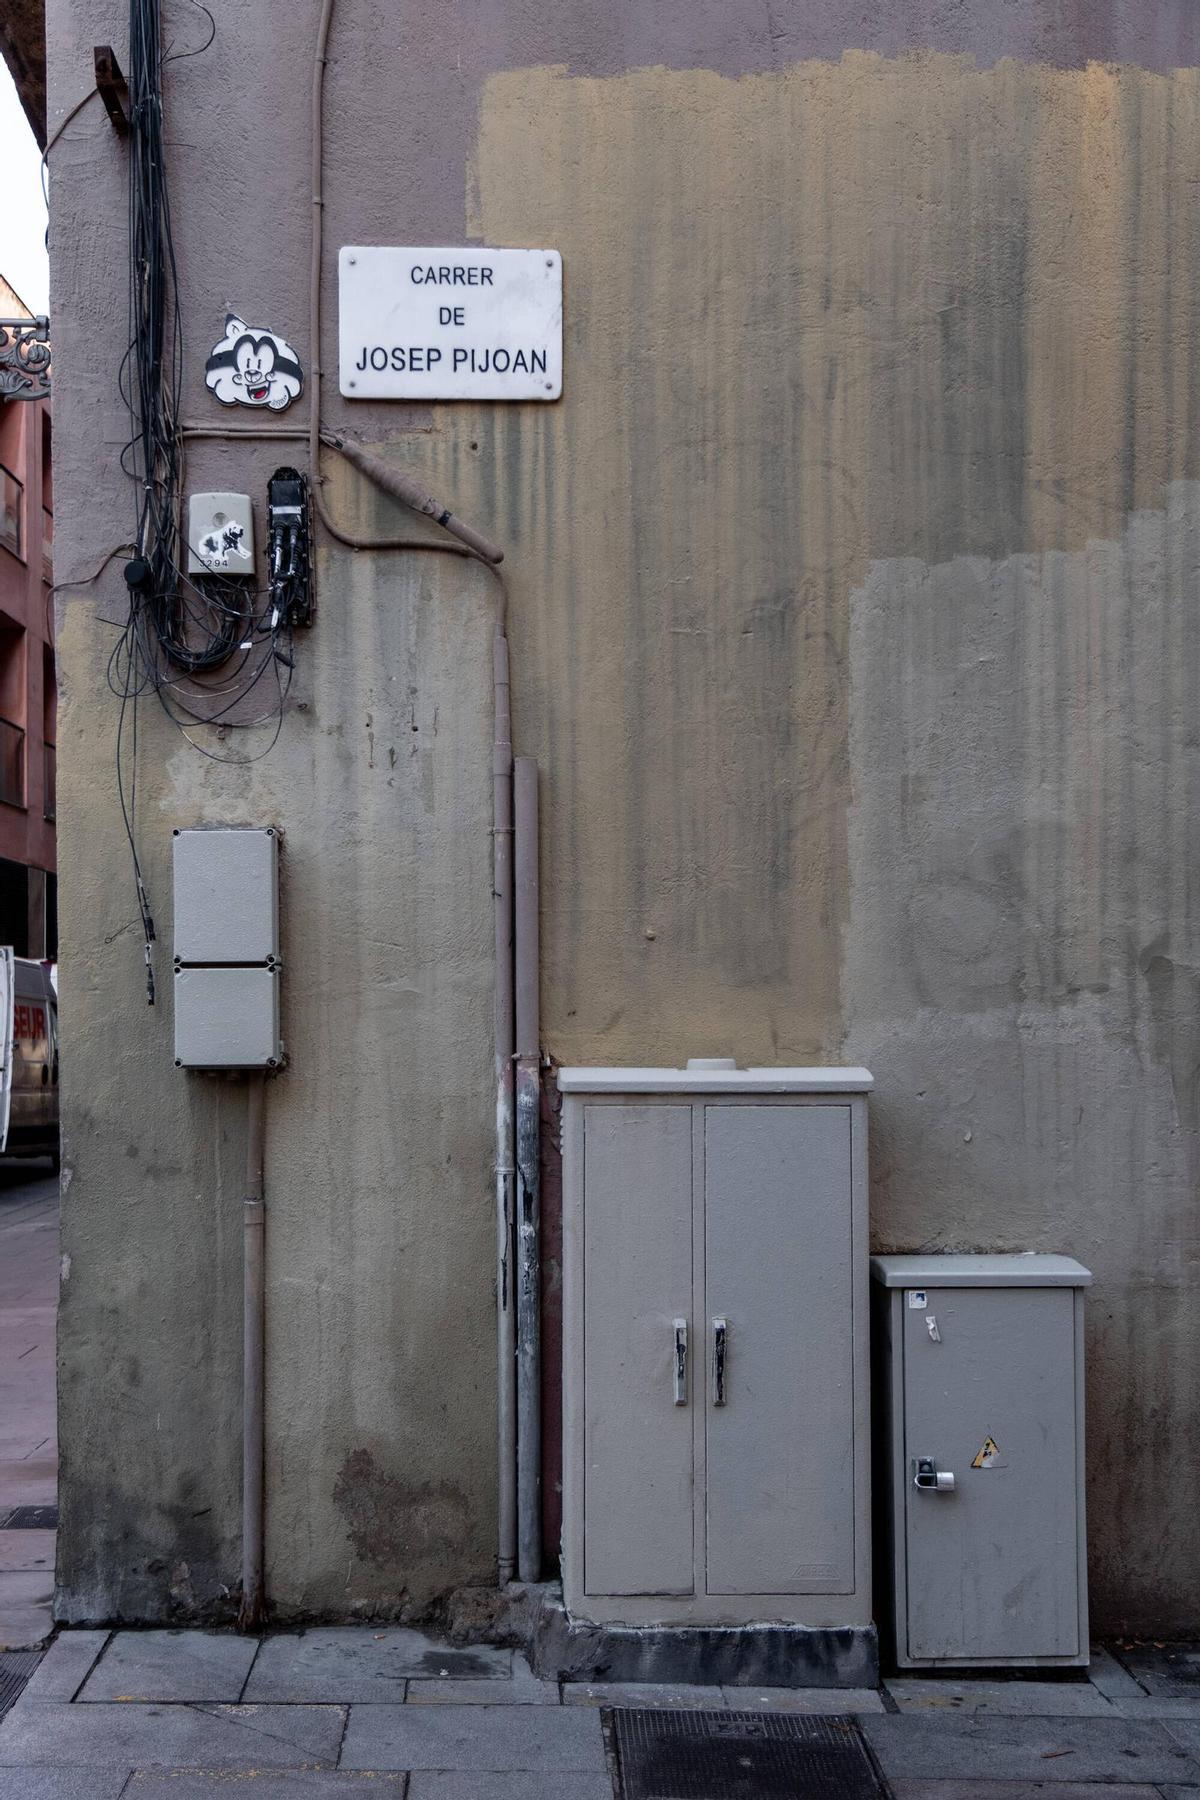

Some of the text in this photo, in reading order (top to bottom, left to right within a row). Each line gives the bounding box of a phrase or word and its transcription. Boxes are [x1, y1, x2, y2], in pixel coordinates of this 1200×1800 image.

[411, 266, 493, 285] CARRER
[440, 307, 464, 326] DE
[356, 347, 546, 373] JOSEP PIJOAN
